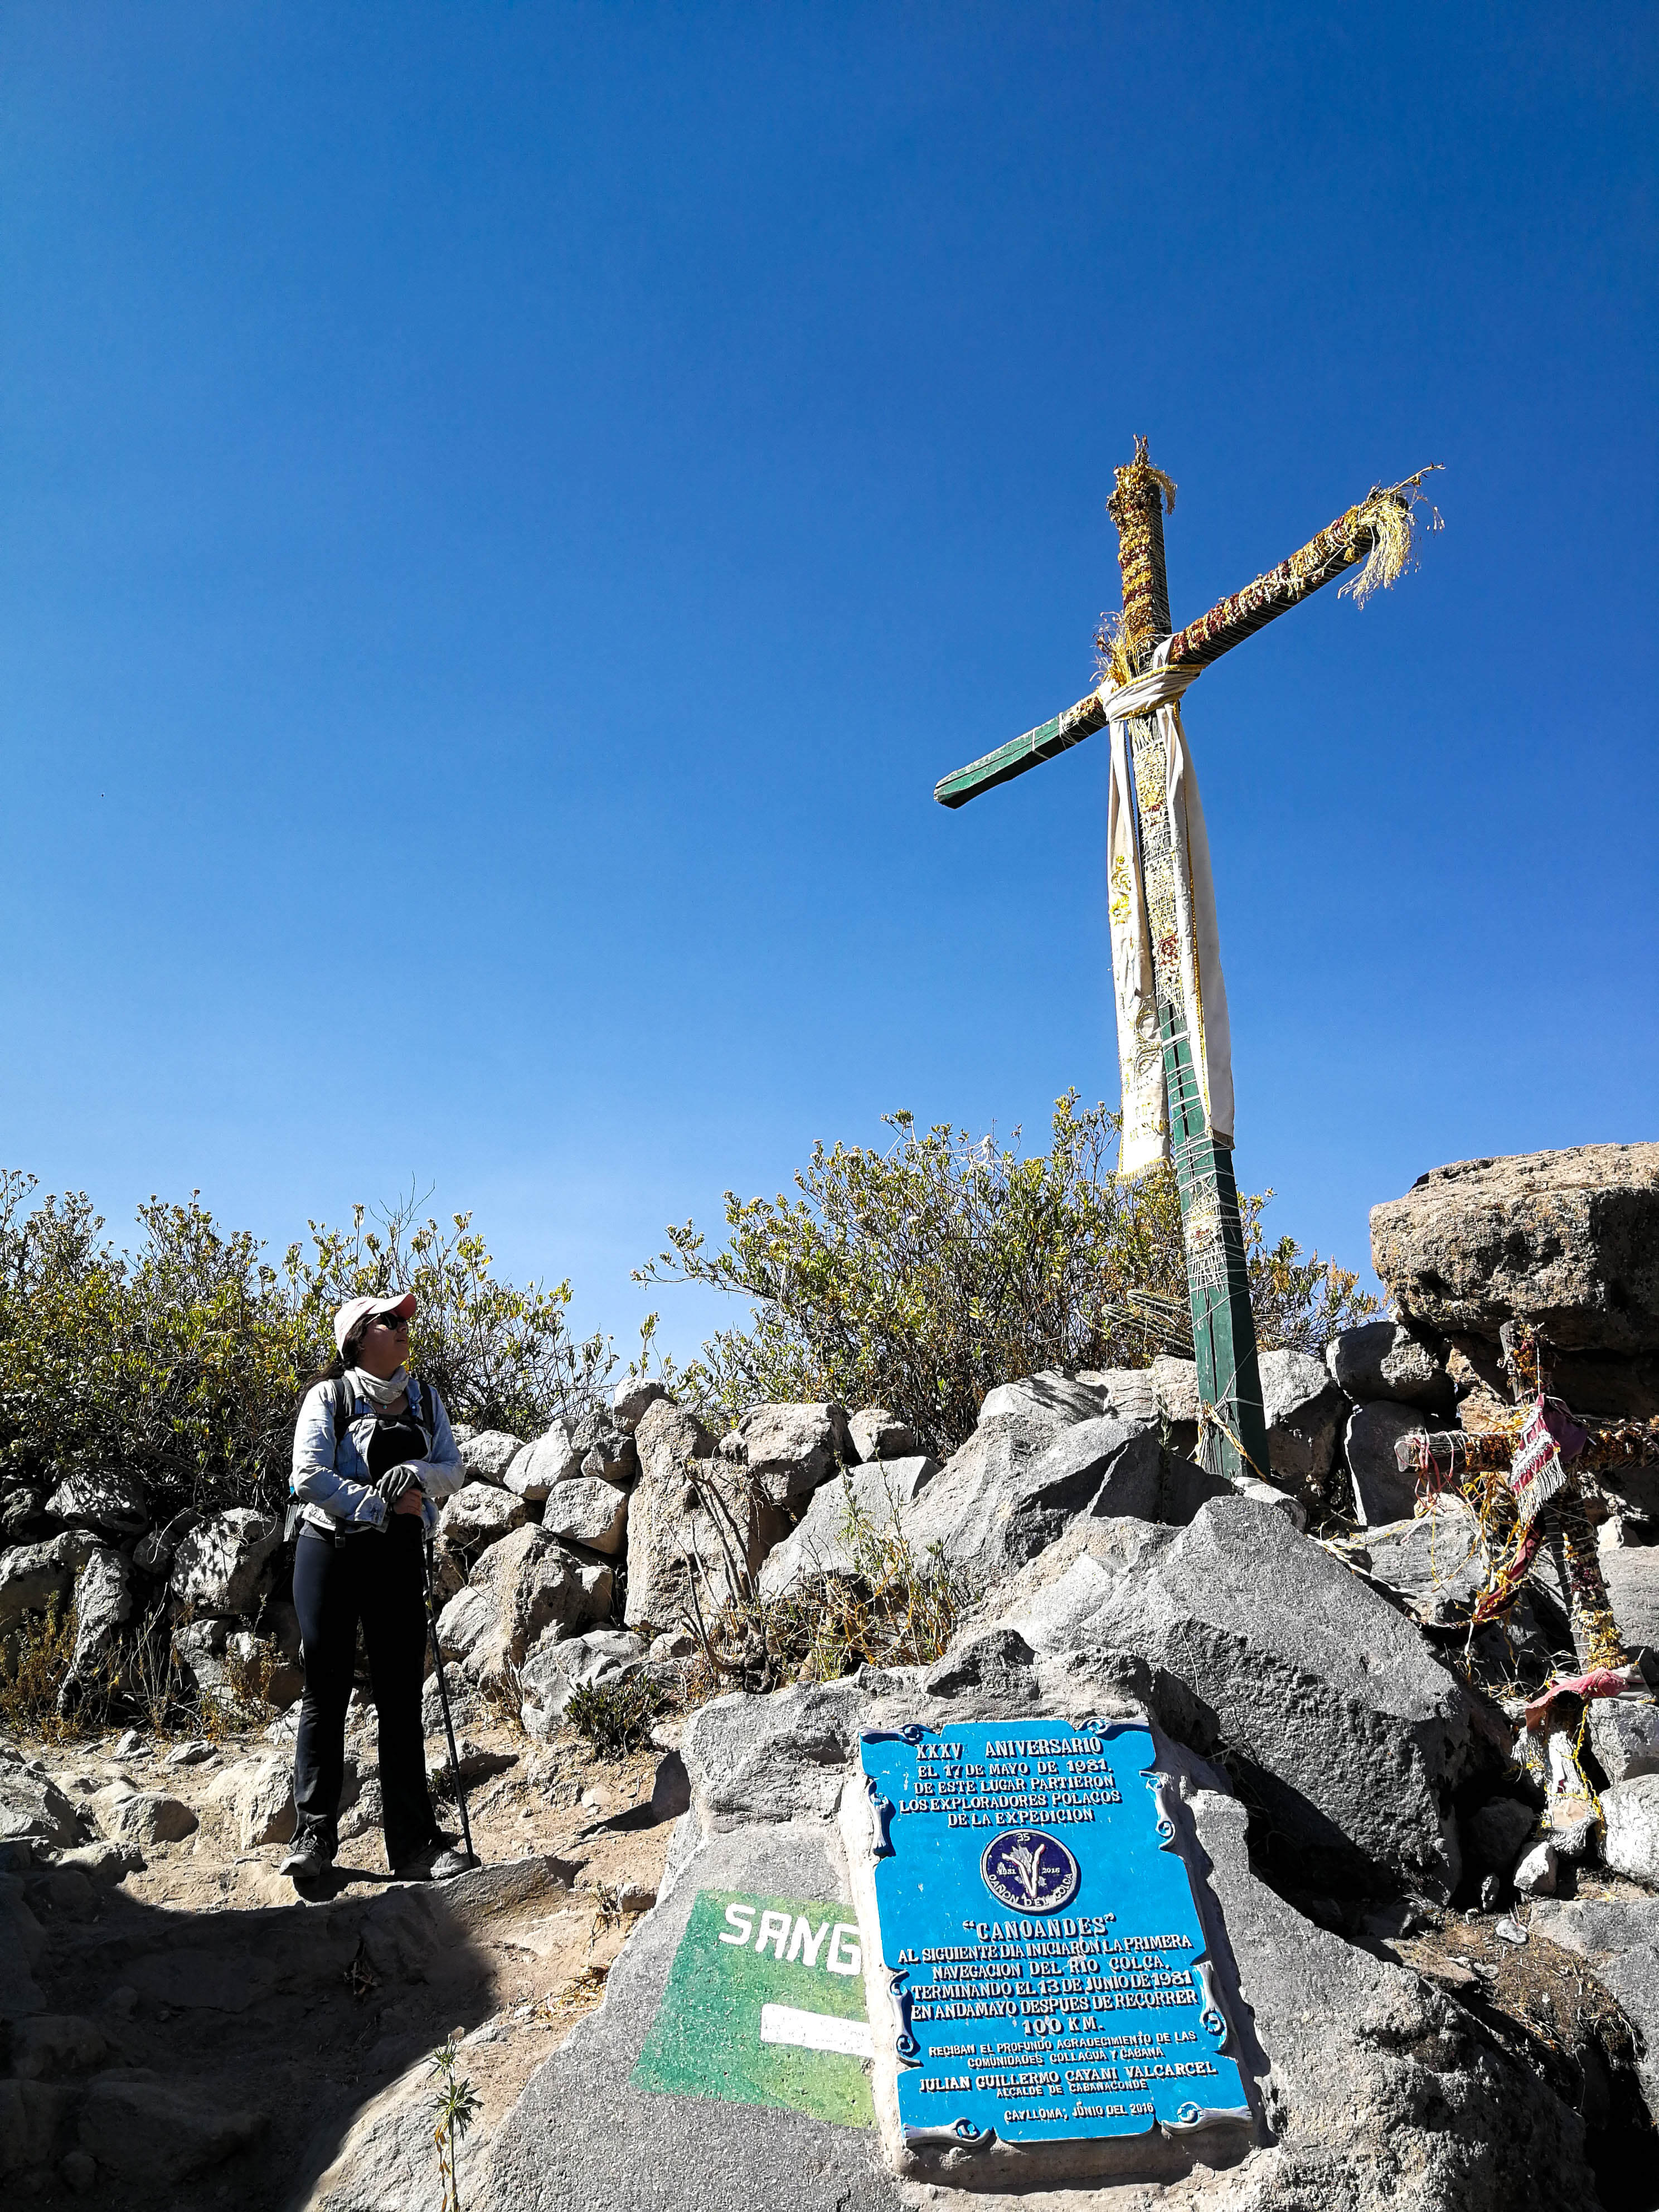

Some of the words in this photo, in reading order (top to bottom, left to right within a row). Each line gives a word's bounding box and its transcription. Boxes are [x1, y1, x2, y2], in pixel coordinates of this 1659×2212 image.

[915, 1743, 962, 1759] XXXV
[986, 1737, 1102, 1758] ANIVERSARIO
[918, 1765, 938, 1778] EL
[944, 1764, 961, 1777] 17
[966, 1764, 984, 1777] DE
[989, 1763, 1029, 1776] MAYO
[1037, 1761, 1058, 1774] DE
[1066, 1759, 1113, 1773] 1981.
[914, 1782, 935, 1795] DE
[939, 1780, 977, 1794] ESTE
[981, 1777, 1026, 1792] LUGAR
[1030, 1775, 1114, 1791] PARTIERON
[899, 1799, 929, 1813] LOS
[931, 1794, 1046, 1811] EXPLORADORES
[1052, 1790, 1120, 1805] POLACOS
[948, 1814, 969, 1827] DE
[972, 1812, 991, 1826] LA
[996, 1808, 1095, 1825] EXPEDICION
[1016, 1832, 1030, 1842] 35
[898, 1949, 919, 1963] AL
[922, 1944, 997, 1962] SIGUIENTE
[1000, 1943, 1026, 1959] DIA
[1027, 1939, 1102, 1958] INICIARON
[1102, 1938, 1123, 1952] LA
[1123, 1934, 1193, 1951] PRIMERA
[933, 1963, 1022, 1981] NAVEGACION
[1029, 1961, 1063, 1976] DEL
[1069, 1958, 1099, 1973] RIO
[1109, 1955, 1170, 1971] COLCA.
[911, 1983, 1014, 2001] TERMINANDO
[1015, 1981, 1036, 1996] EL
[1039, 1980, 1060, 1995] 13
[1062, 1978, 1083, 1993] DE
[1086, 1975, 1129, 1992] JUNIO
[1129, 1973, 1152, 1988] DE
[1152, 1970, 1194, 1986] 1981
[911, 2005, 934, 2021] EN
[935, 2000, 1019, 2019] ANDAMAYO
[1020, 1997, 1090, 2015] DESPUES
[1091, 1995, 1114, 2010] DE
[1115, 1990, 1199, 2008] RECORRER
[1022, 2017, 1064, 2035] 100
[1068, 2016, 1105, 2032] KM.
[929, 2044, 976, 2057] RECIBAN
[980, 2043, 995, 2055] EL
[997, 2040, 1053, 2054] PROFUNDO
[1056, 2033, 1152, 2050] AGRADECIMIENTO
[1156, 2032, 1171, 2044] DE
[1175, 2031, 1197, 2042] LAS
[968, 2055, 1045, 2069] COMUNIDADES
[1050, 2051, 1108, 2063] COLLAGUA
[1110, 2050, 1119, 2061] Y
[1120, 2046, 1165, 2060] CABANA
[919, 2076, 972, 2093] JULIAN
[976, 2071, 1061, 2090] GUILLERMO
[1065, 2067, 1118, 2082] CAYANI
[1123, 2061, 1218, 2079] VALCARCEL
[997, 2085, 1045, 2099] ALCALDE
[1050, 2084, 1064, 2095] DE
[1069, 2079, 1148, 2094] CABANACONDE
[1106, 2104, 1128, 2117] DEL
[1129, 2102, 1155, 2116] 2016
